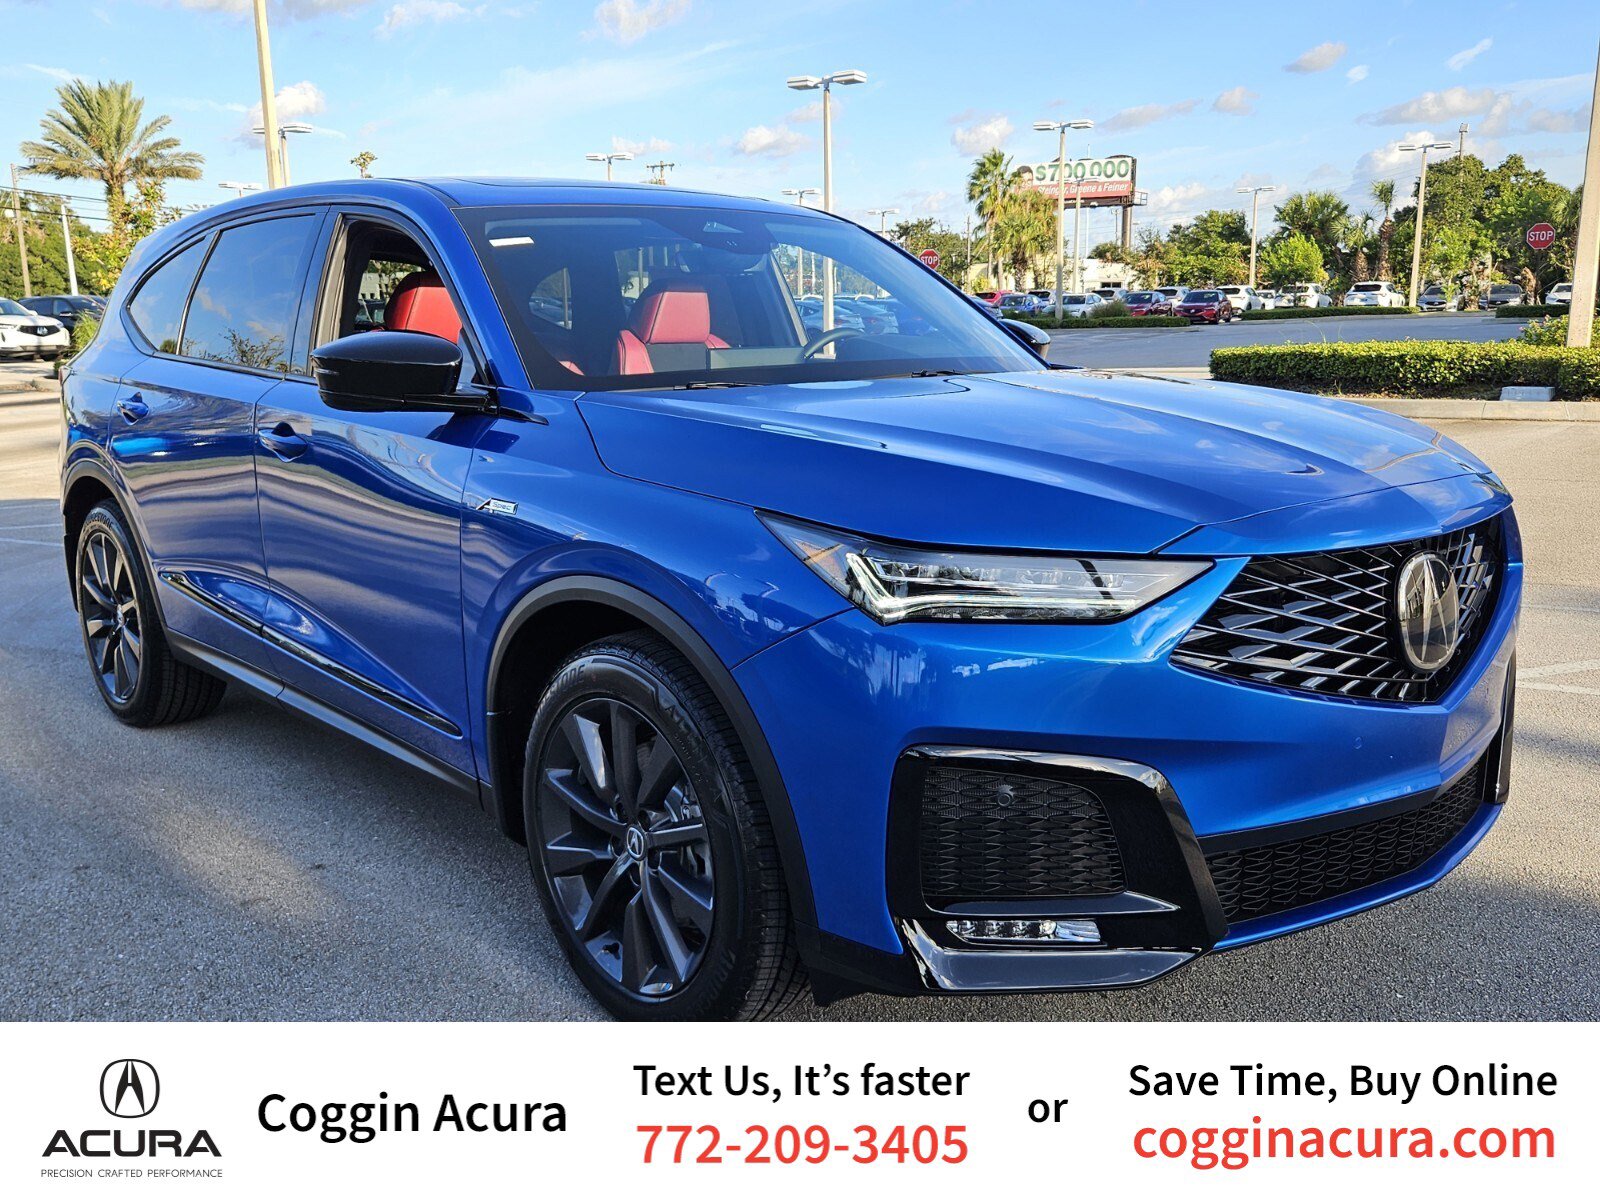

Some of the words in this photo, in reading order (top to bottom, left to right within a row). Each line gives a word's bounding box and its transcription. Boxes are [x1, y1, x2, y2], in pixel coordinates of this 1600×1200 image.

[1103, 182, 1129, 192] Feiner
[1528, 230, 1554, 241] STOP
[920, 255, 938, 265] STOP
